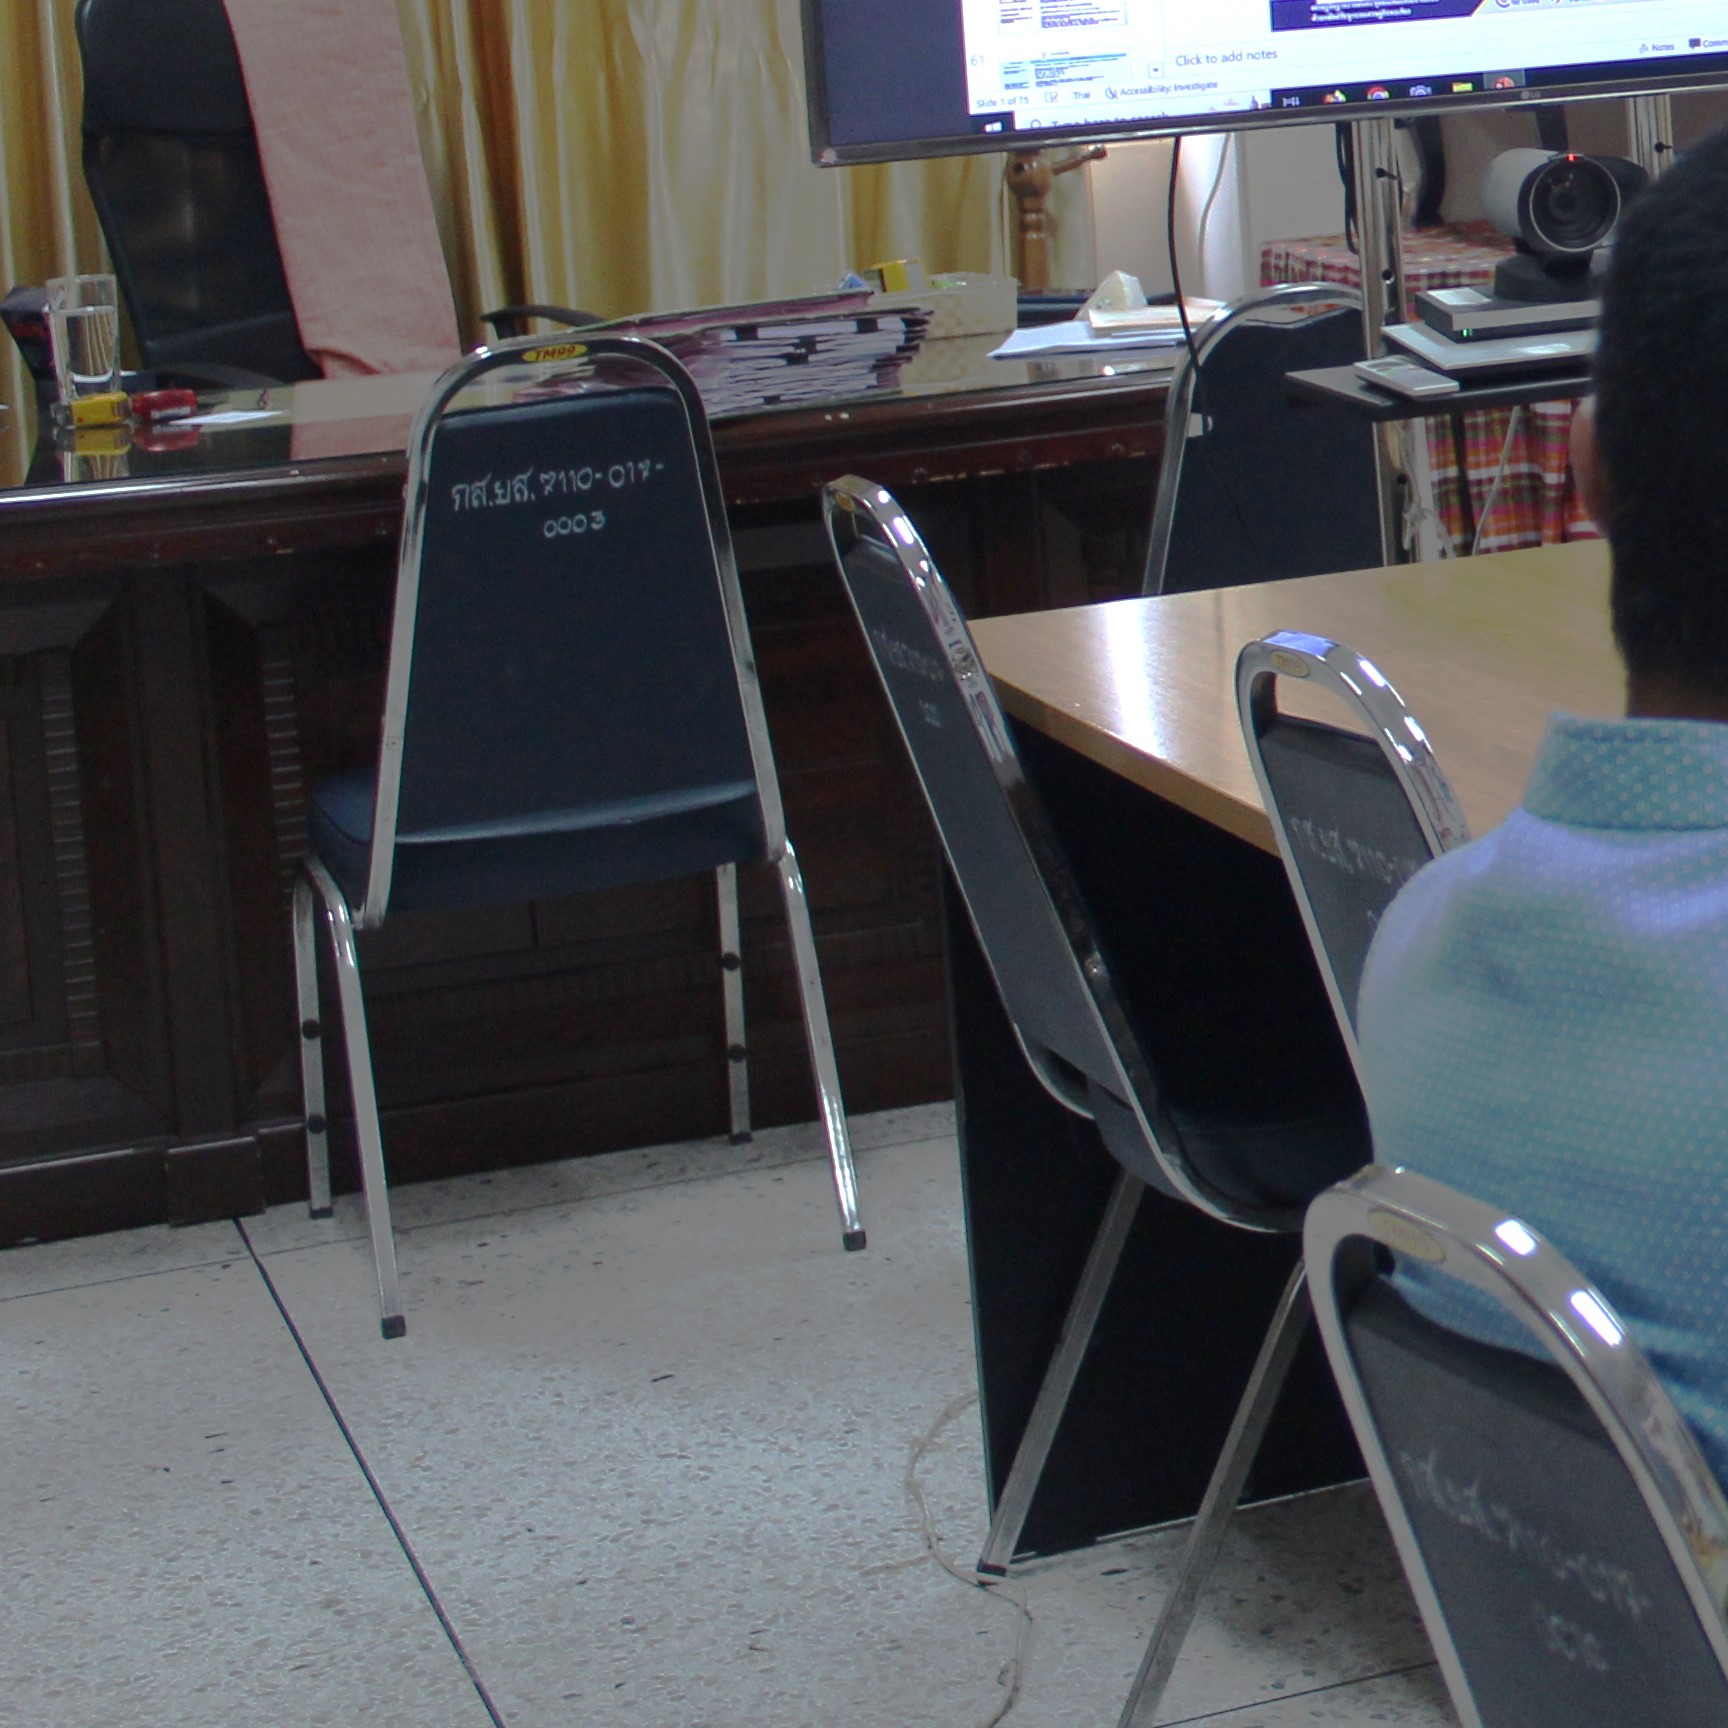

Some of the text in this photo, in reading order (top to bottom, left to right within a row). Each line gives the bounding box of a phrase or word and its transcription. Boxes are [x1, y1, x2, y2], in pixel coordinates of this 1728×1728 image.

[1651, 43, 1675, 52] Notes
[970, 54, 985, 67] 61
[1174, 49, 1278, 67] Click to add notes
[1119, 80, 1219, 97] Accessibility: Investigate
[1073, 90, 1091, 101] Thai
[976, 98, 998, 109] Slide
[542, 508, 607, 539] 0003
